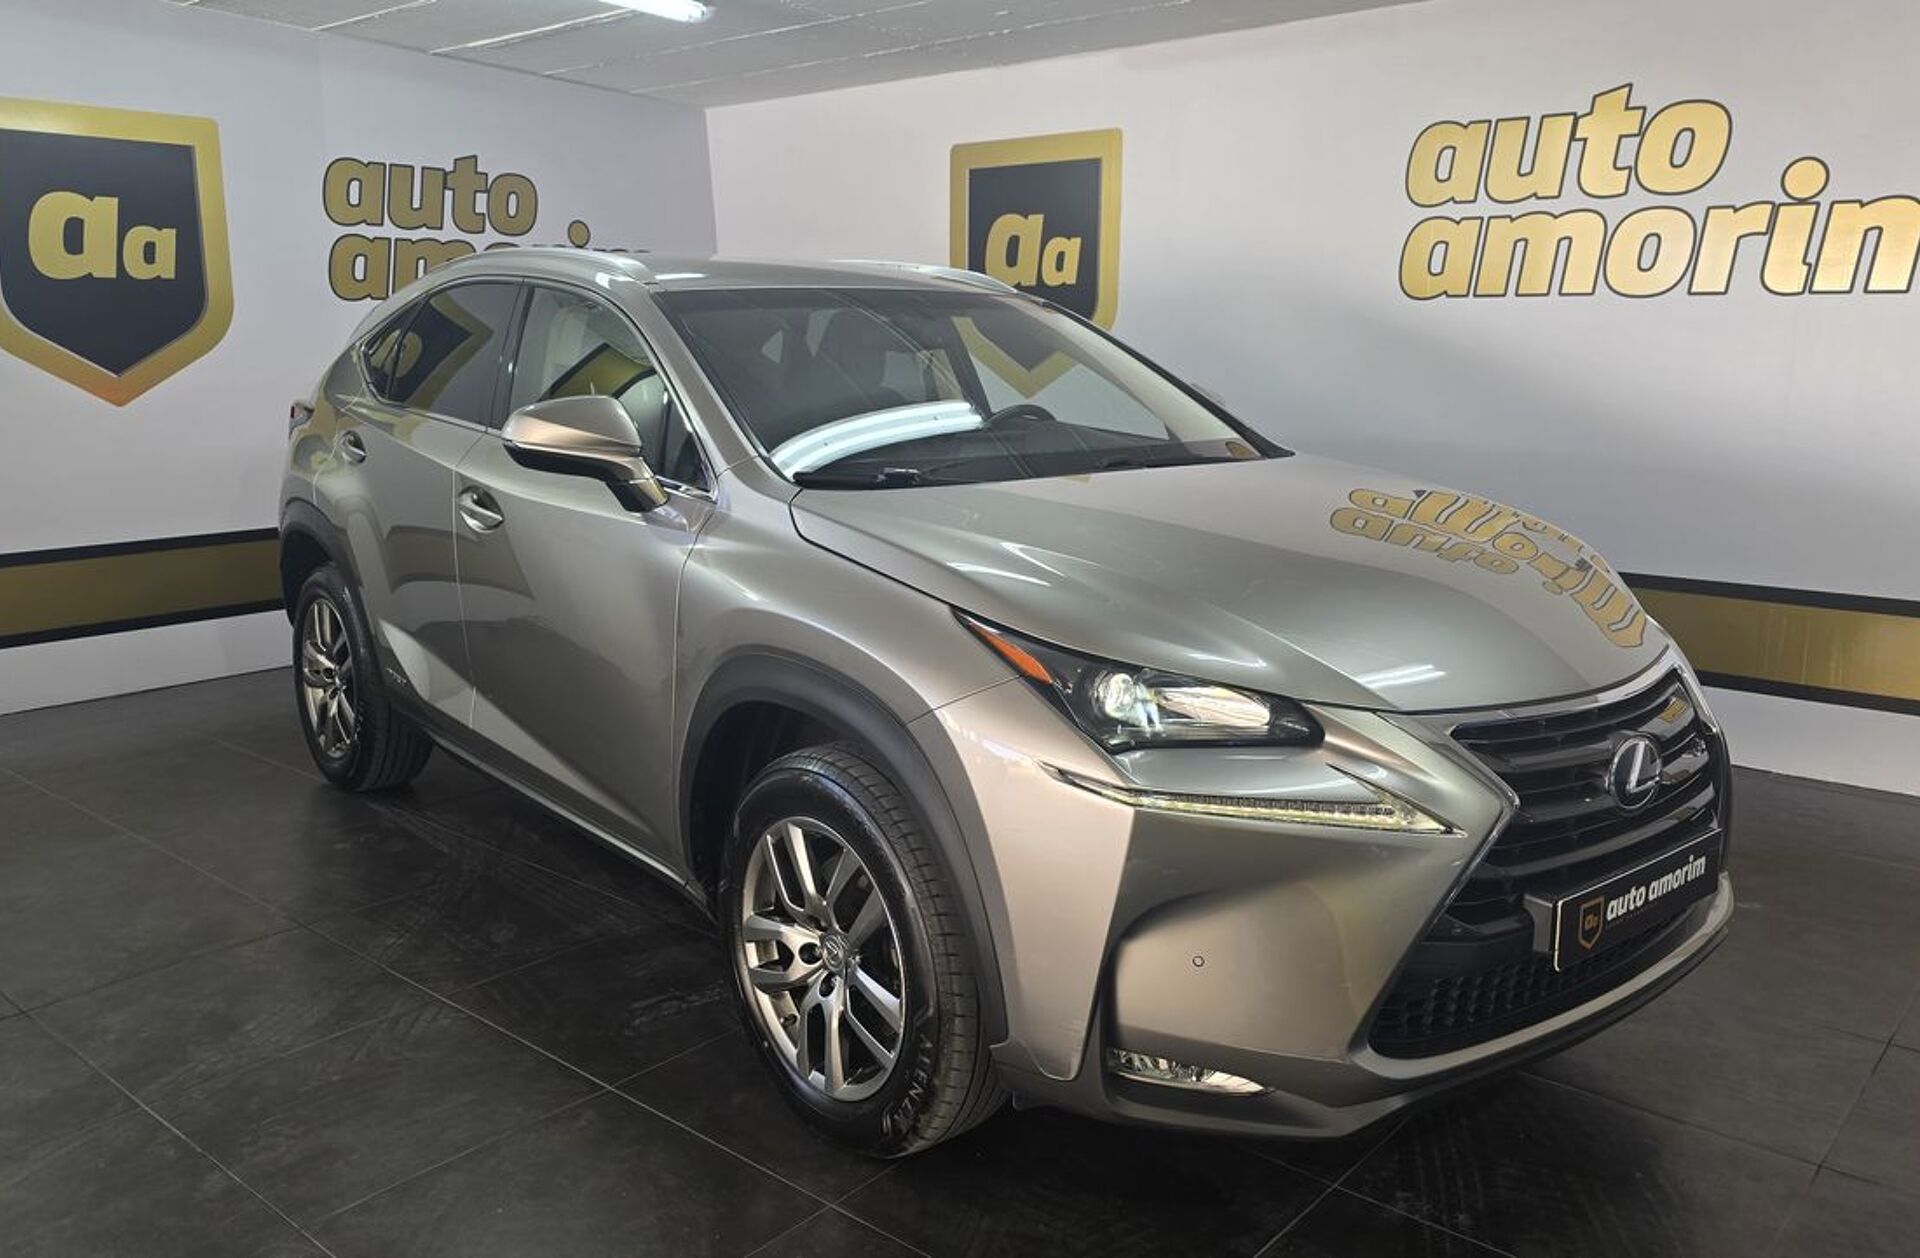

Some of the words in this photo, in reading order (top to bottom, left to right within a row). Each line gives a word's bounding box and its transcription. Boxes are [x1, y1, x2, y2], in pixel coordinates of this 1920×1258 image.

[1405, 82, 1733, 208] auto
[27, 191, 177, 280] aa
[322, 155, 538, 236] auto
[1606, 886, 1646, 921] auto
[1648, 854, 1706, 901] amorim
